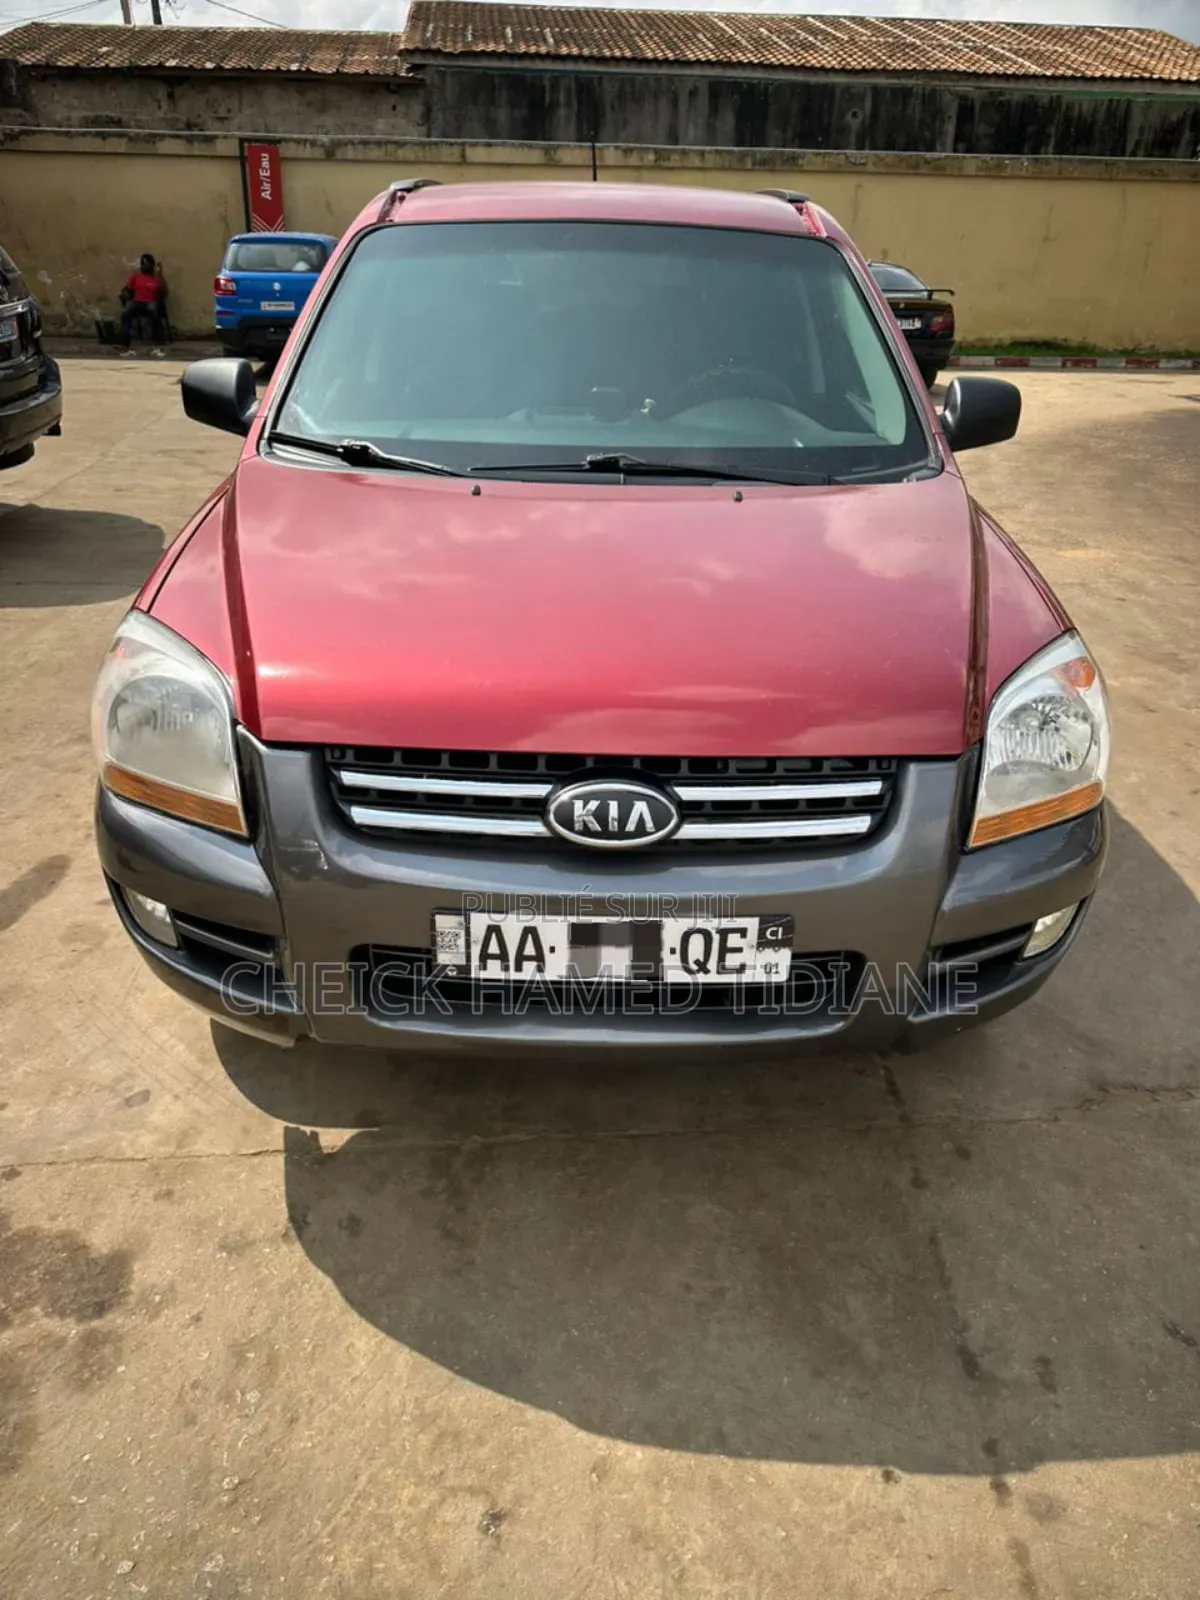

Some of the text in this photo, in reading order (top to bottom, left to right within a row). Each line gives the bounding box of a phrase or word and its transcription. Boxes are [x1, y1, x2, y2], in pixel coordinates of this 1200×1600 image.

[258, 153, 272, 200] Air/Eau
[572, 799, 656, 833] KIA
[765, 926, 783, 940] CI
